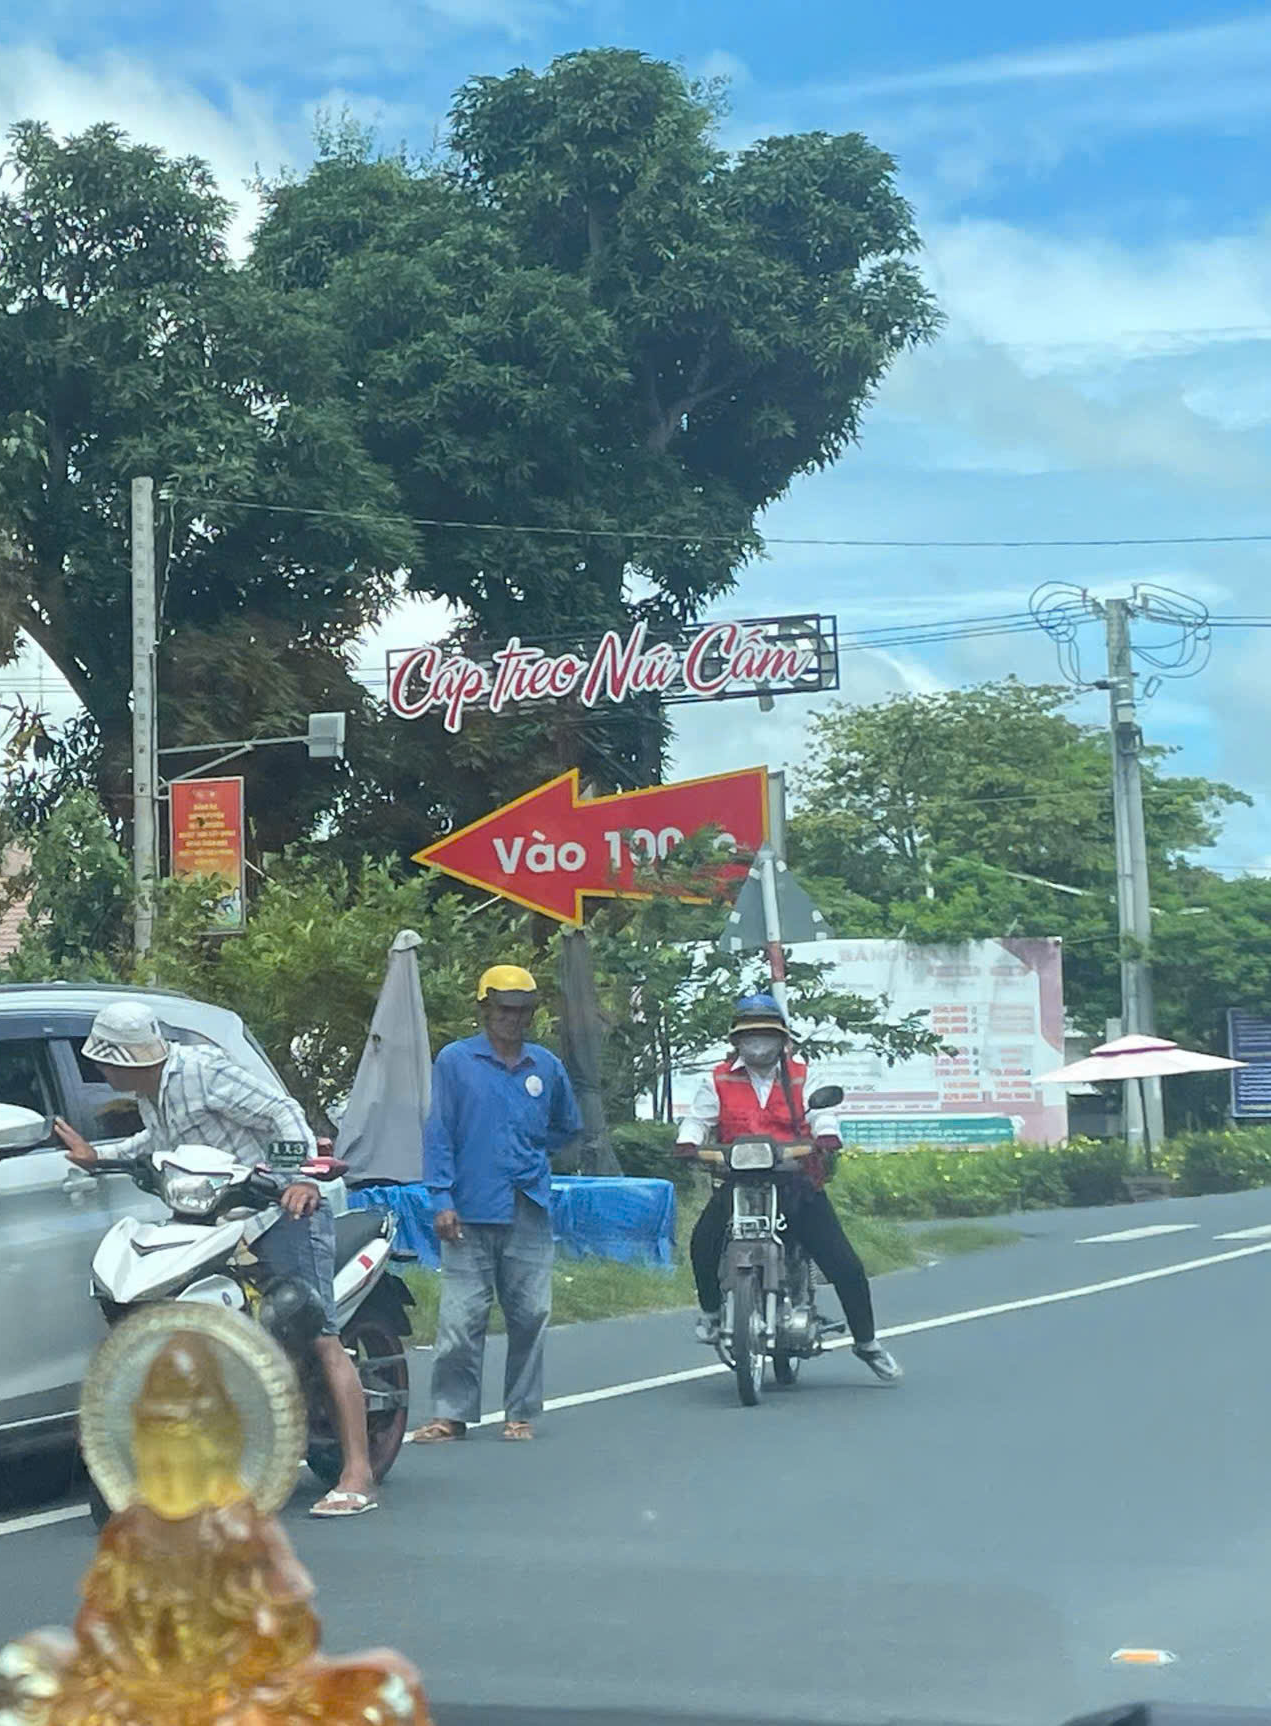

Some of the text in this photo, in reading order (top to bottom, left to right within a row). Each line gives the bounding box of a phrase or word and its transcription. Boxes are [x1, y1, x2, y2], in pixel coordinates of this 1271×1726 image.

[390, 619, 815, 733] Cáp treo Núi Cấm
[492, 829, 587, 874] Vào
